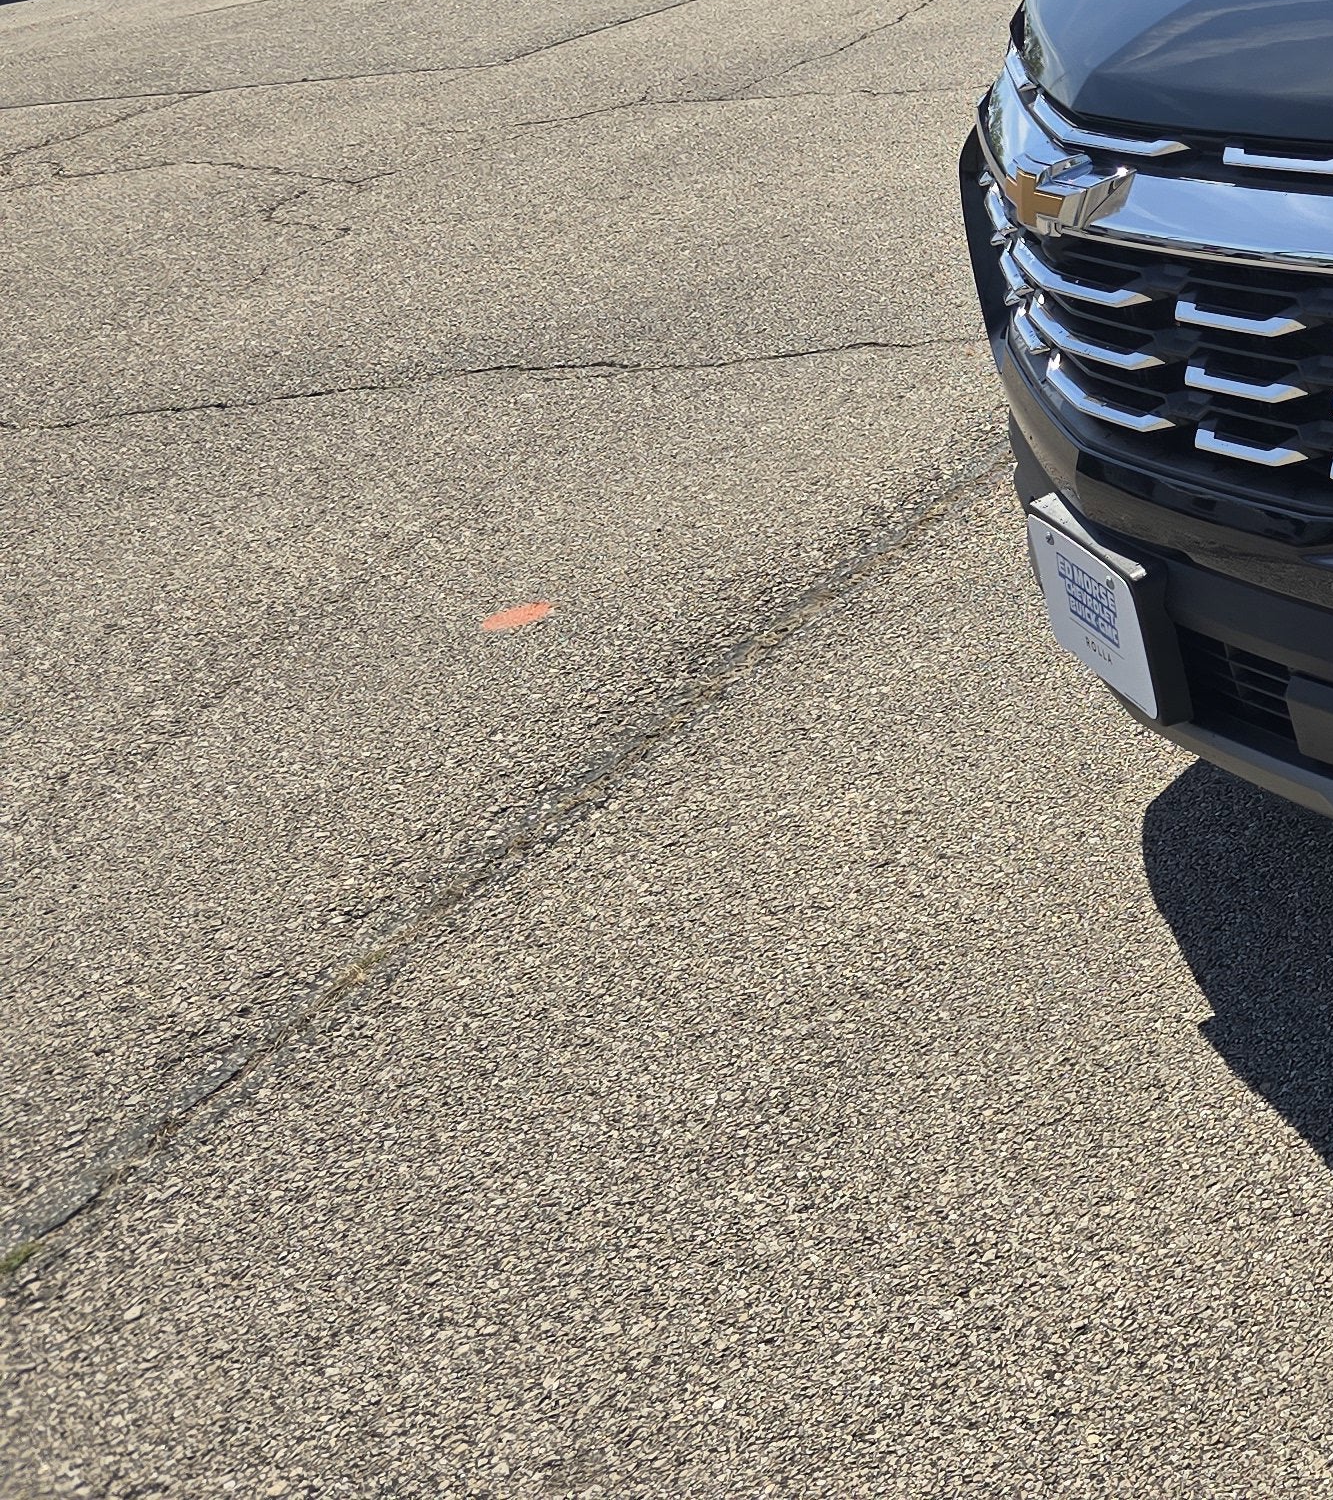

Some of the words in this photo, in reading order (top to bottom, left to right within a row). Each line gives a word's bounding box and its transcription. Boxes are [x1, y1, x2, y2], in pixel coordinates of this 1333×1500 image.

[1057, 553, 1072, 580] ED
[1073, 565, 1117, 613] MORSE
[1065, 580, 1116, 626] CHEVROLET
[1069, 598, 1098, 628] BUICK
[1085, 636, 1113, 665] ROLLA
